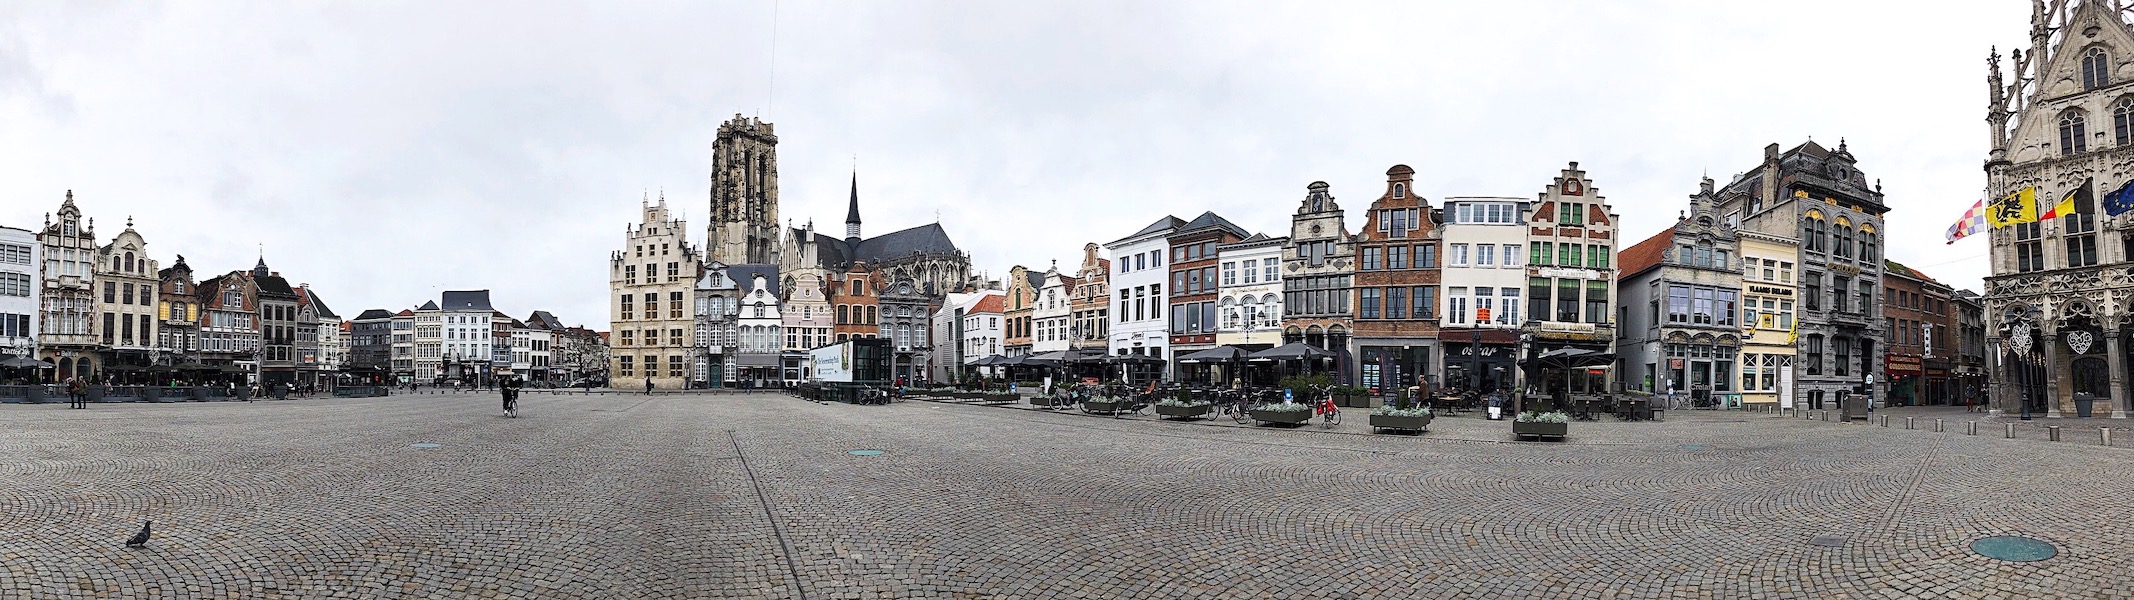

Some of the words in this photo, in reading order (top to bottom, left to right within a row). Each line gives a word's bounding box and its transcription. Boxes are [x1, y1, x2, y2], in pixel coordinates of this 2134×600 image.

[1749, 285, 1771, 293] VLAAMS
[1772, 288, 1793, 296] BELANG
[1462, 346, 1498, 357] osar
[1690, 383, 1713, 391] Crelan
